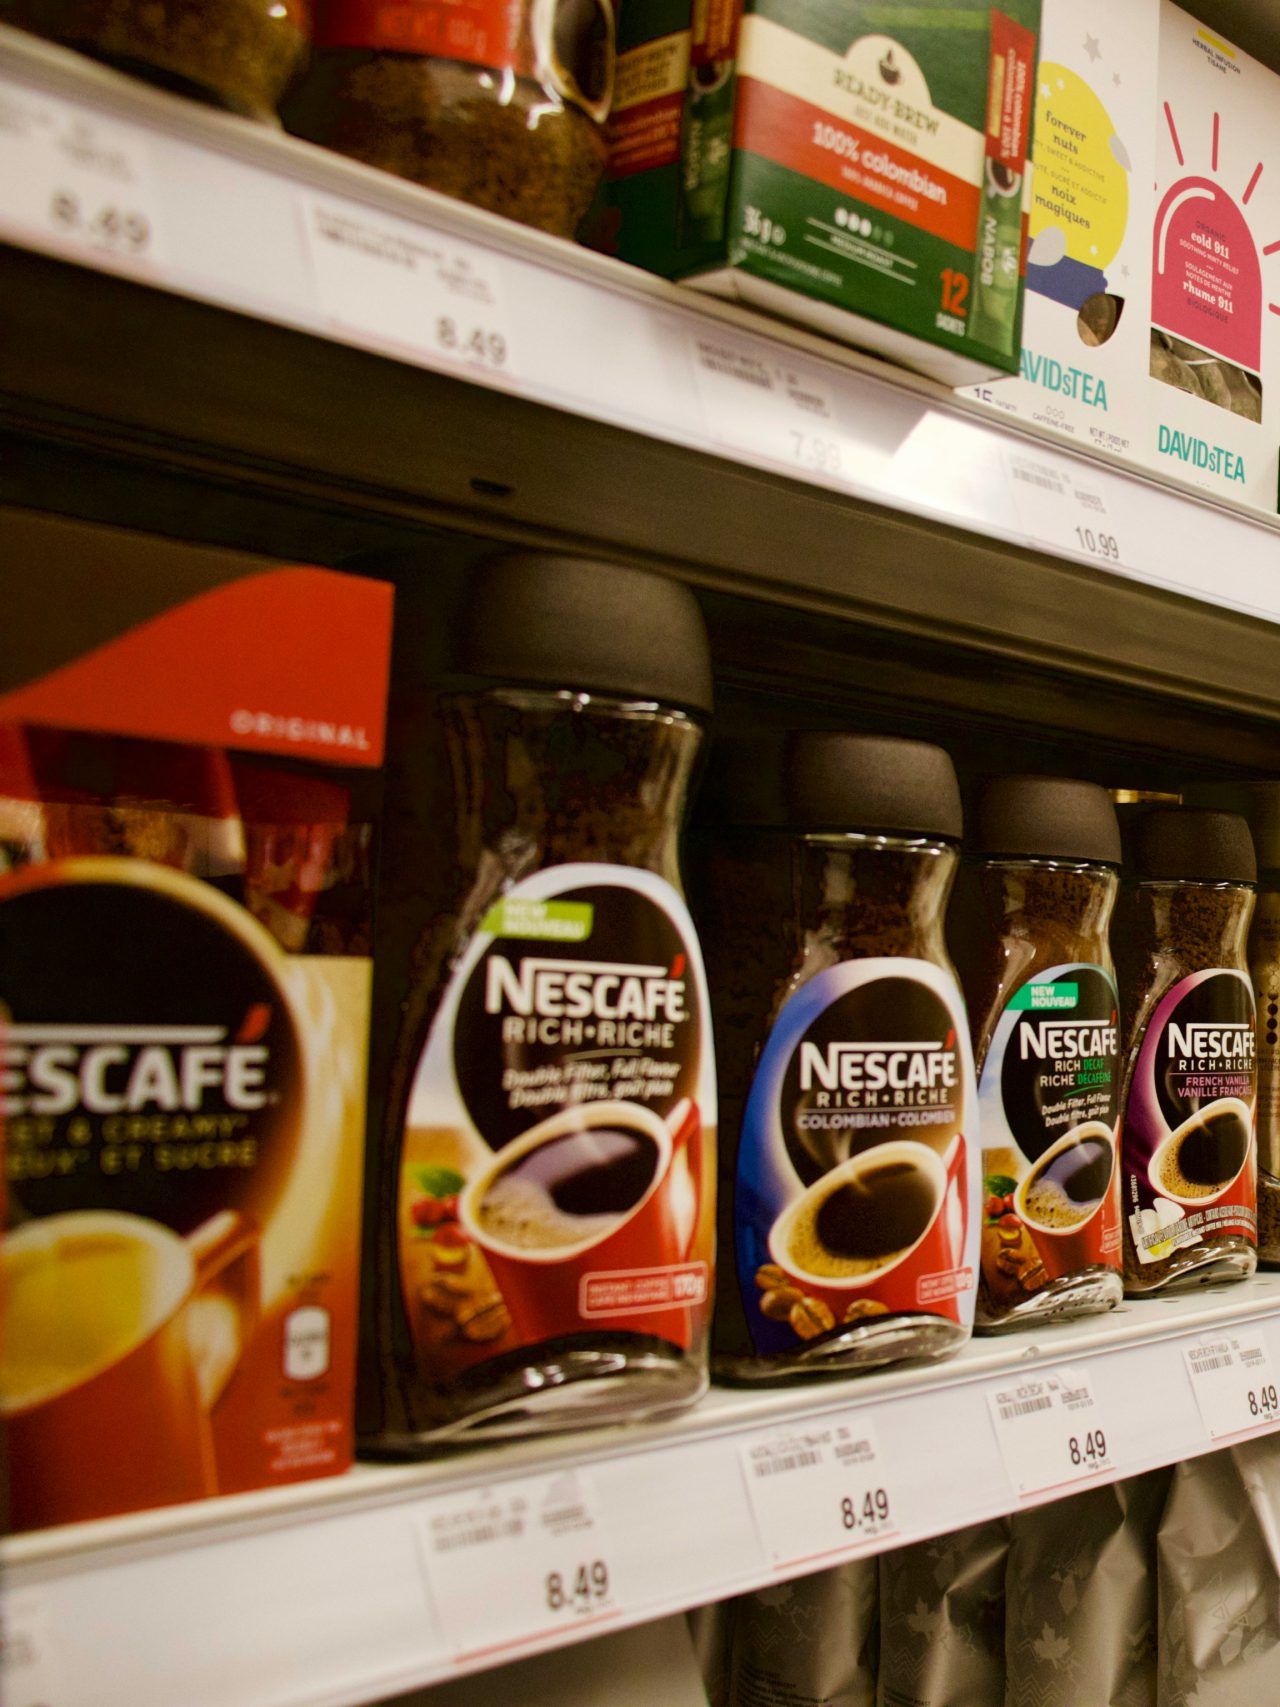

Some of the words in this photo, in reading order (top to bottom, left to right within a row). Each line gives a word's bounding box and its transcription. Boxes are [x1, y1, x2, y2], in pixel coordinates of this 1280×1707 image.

[1045, 110, 1087, 143] forever
[1053, 134, 1079, 155] nuts
[860, 149, 948, 206] colombian
[1051, 184, 1077, 206] noix
[1035, 194, 1091, 230] magiques
[980, 216, 998, 287] NABOB
[1191, 231, 1212, 251] cold
[1213, 240, 1230, 260] 911
[939, 267, 970, 317] 12
[1182, 279, 1216, 305] rhume
[1217, 294, 1234, 315] 911
[436, 316, 507, 367] 8.49
[1074, 525, 1120, 561] 10.99
[229, 708, 371, 751] ORIGINAL
[1030, 985, 1056, 997] NEW
[1030, 996, 1077, 1009] NOUVEAU
[502, 1015, 584, 1046] RICH
[596, 1019, 676, 1049] RICHE
[1039, 1074, 1076, 1088] RICHE
[1054, 1059, 1081, 1072] RICH
[1083, 1058, 1104, 1071] DECAF
[1178, 1059, 1217, 1072] RICH
[1225, 1059, 1253, 1071] RICHE
[1185, 1076, 1223, 1087] FRENCH
[816, 1090, 879, 1108] RICH
[893, 1088, 948, 1106] RICHE
[1177, 1087, 1218, 1098] VANILLE
[797, 1113, 890, 1131] COLOMBIAN
[1247, 1384, 1280, 1417] 8.49
[1068, 1429, 1107, 1466] 8.49
[841, 1488, 890, 1530] 8.49
[546, 1558, 610, 1612] 8.49
